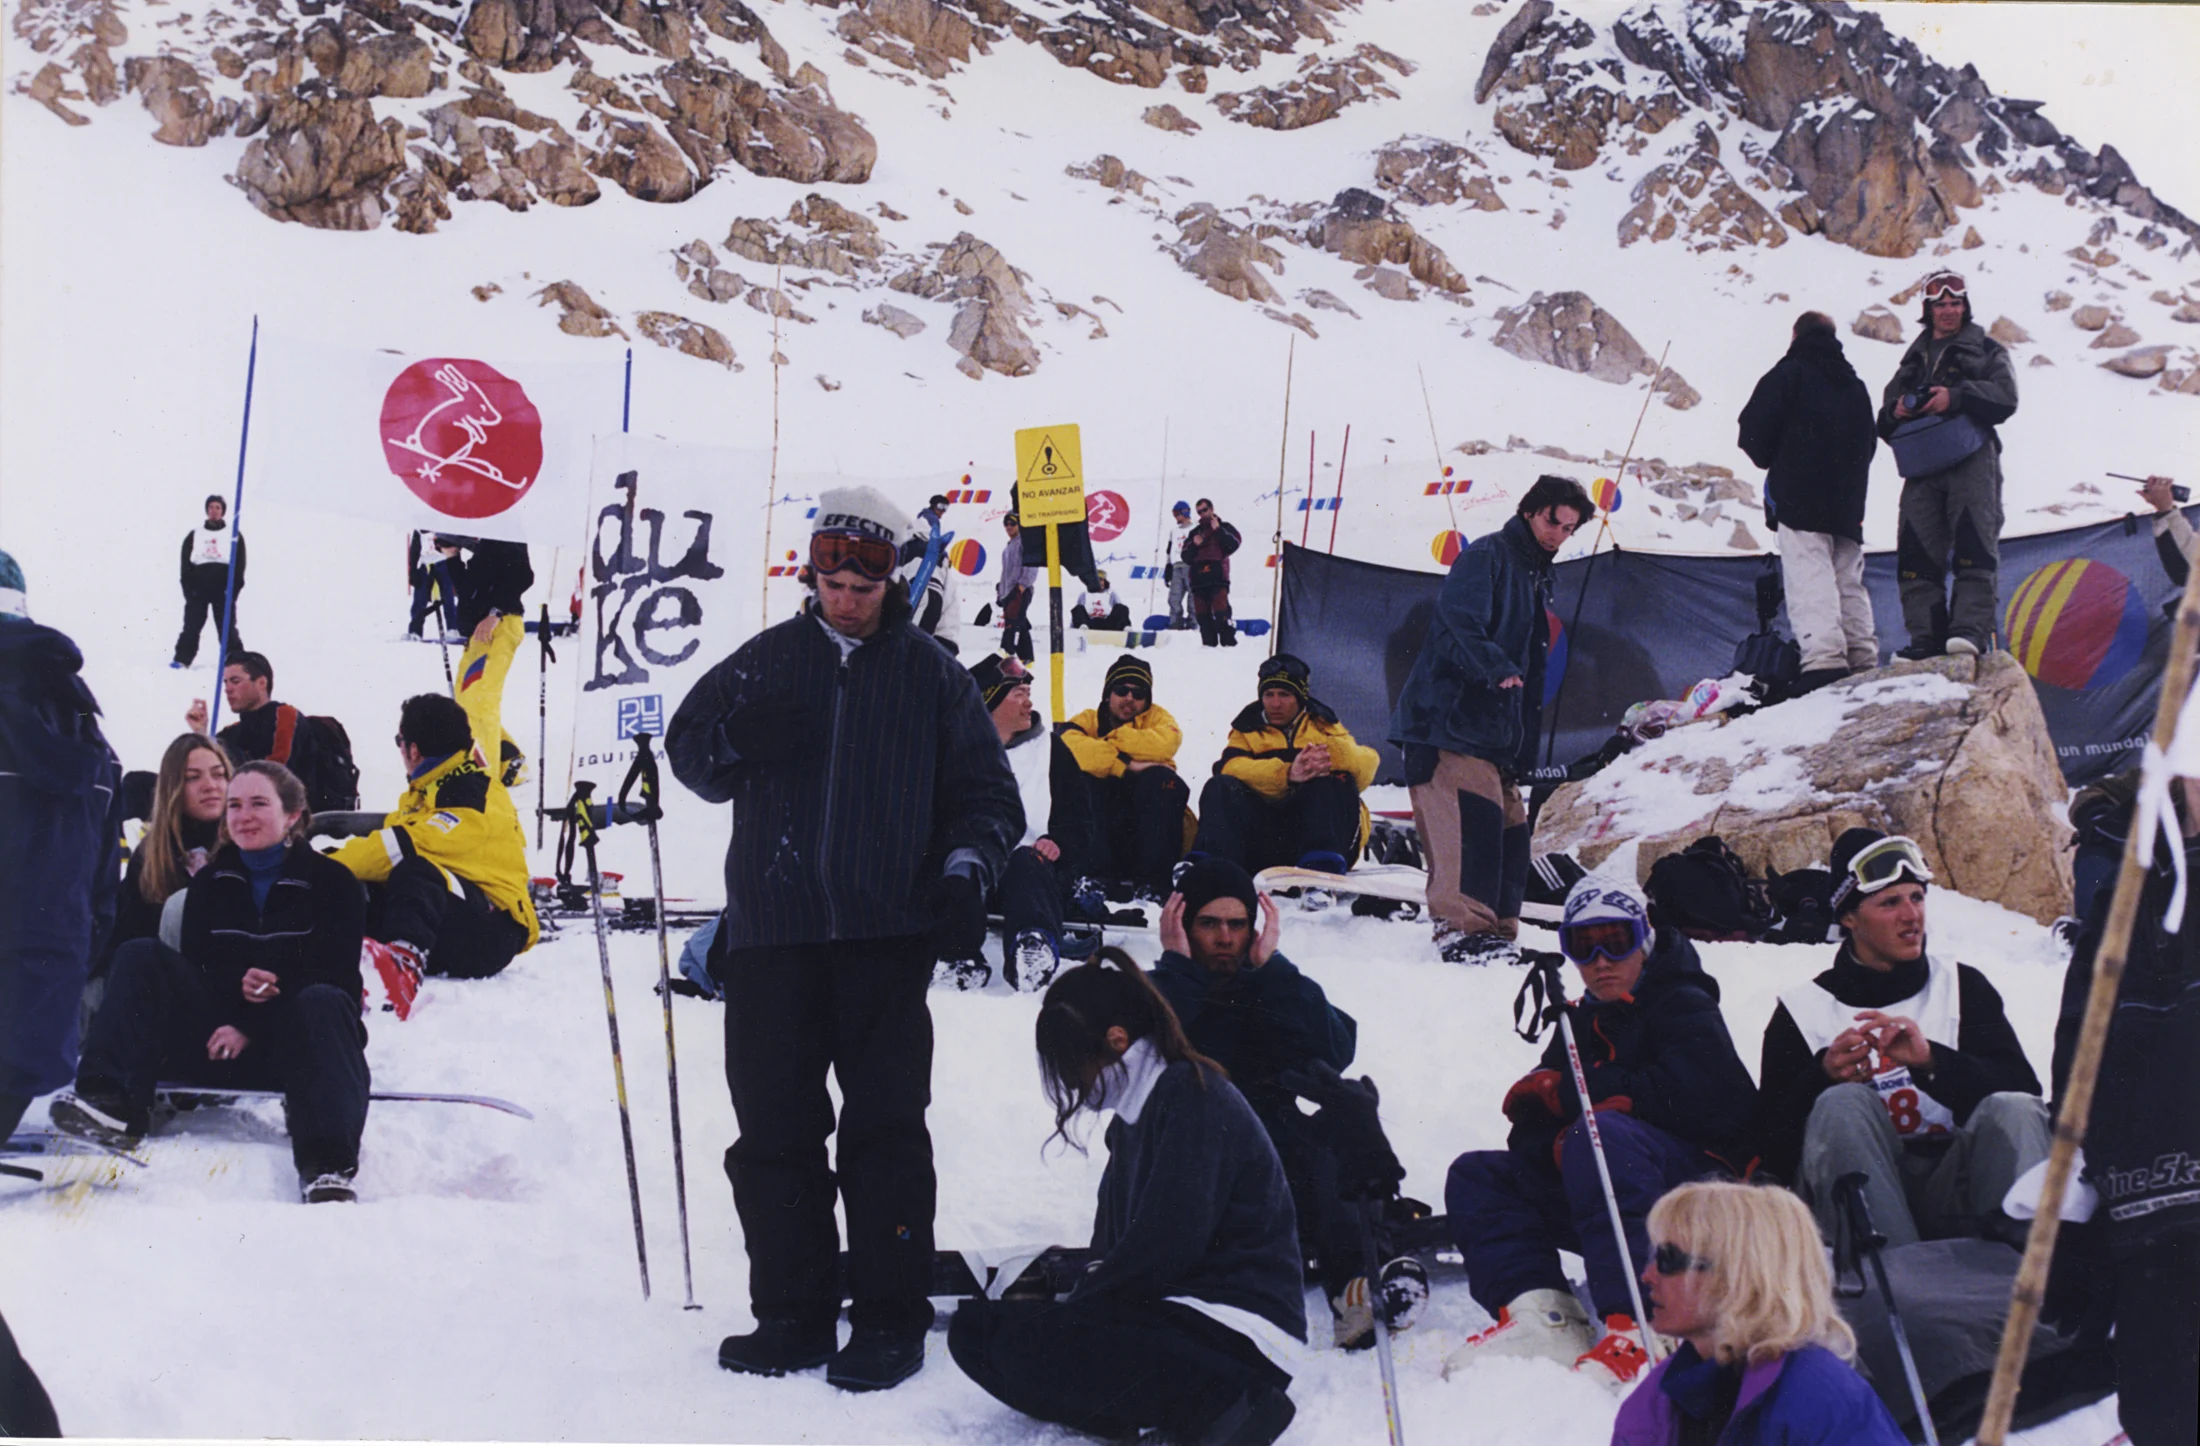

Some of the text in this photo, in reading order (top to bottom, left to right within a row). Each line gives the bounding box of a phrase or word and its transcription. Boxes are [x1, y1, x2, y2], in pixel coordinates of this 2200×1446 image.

[1022, 485, 1081, 499] NO AVANZAR
[592, 470, 724, 583] du
[2059, 745, 2080, 757] un
